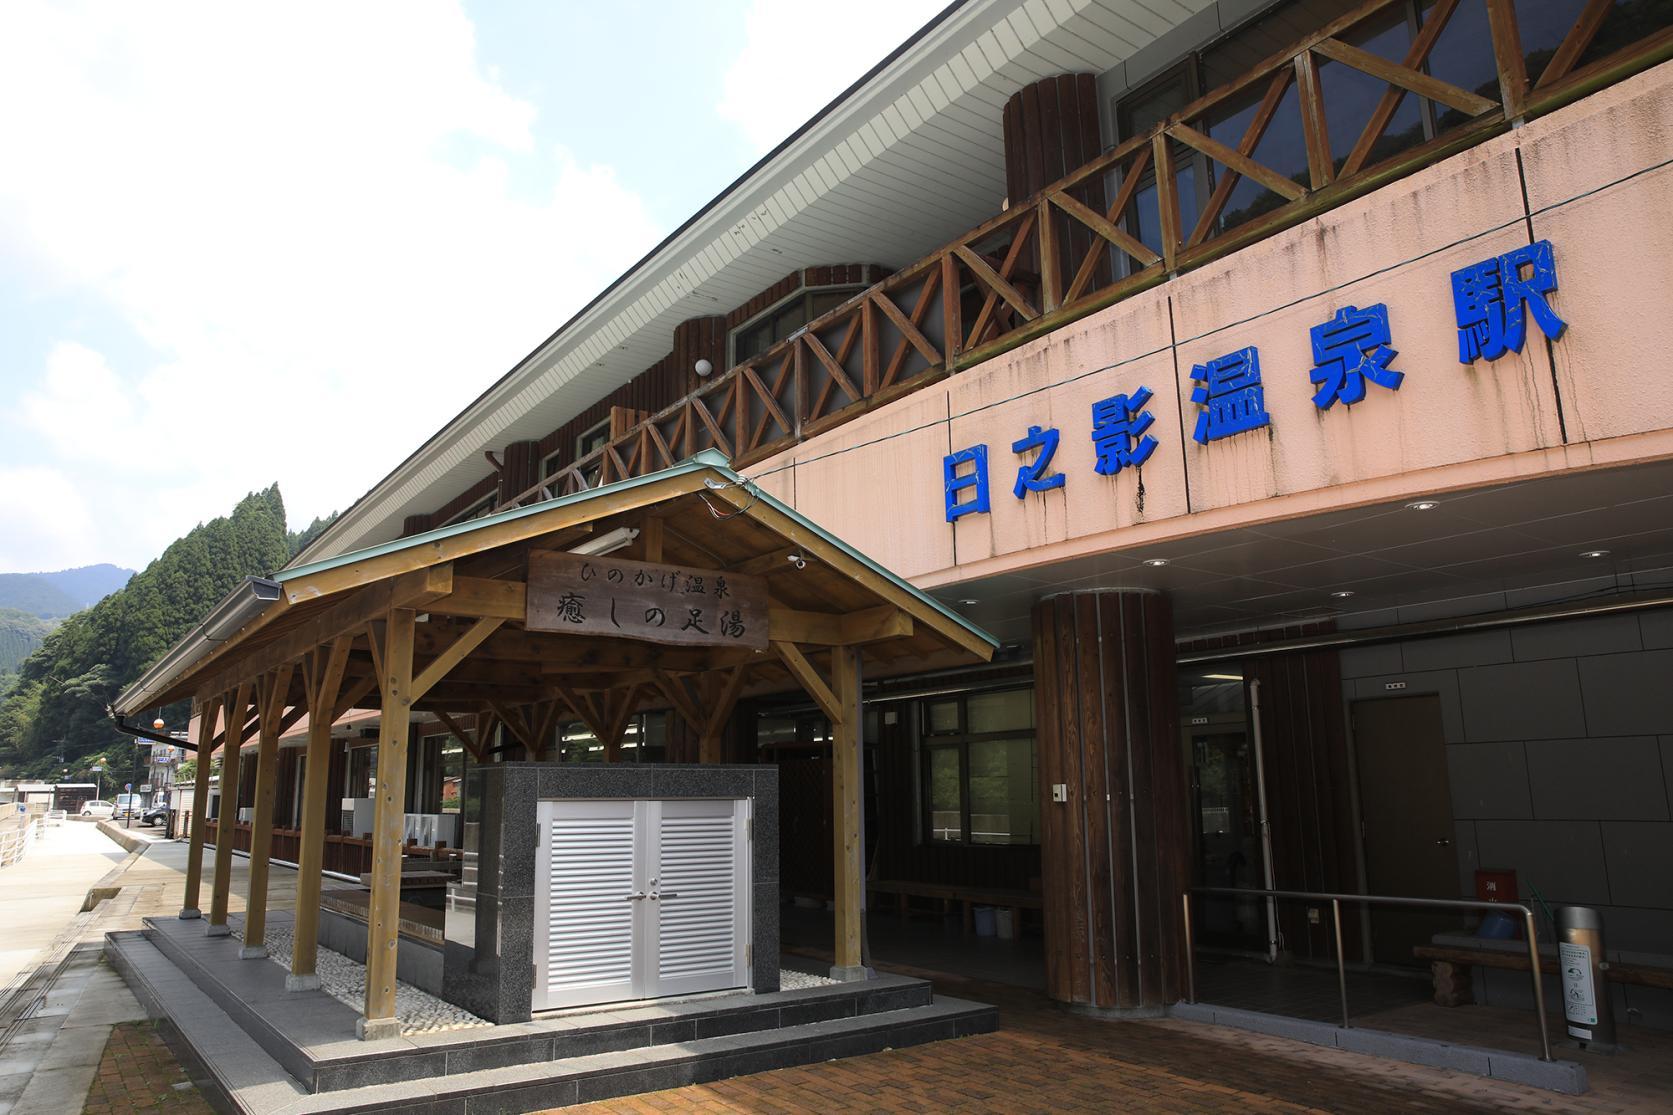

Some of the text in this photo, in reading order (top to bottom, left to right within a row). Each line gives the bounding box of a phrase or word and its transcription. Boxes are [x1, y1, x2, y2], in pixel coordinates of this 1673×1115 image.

[943, 239, 1567, 524] 日之影温泉駅
[581, 563, 730, 599] ひのかげ温泉
[557, 592, 745, 638] 癒しの足湯
